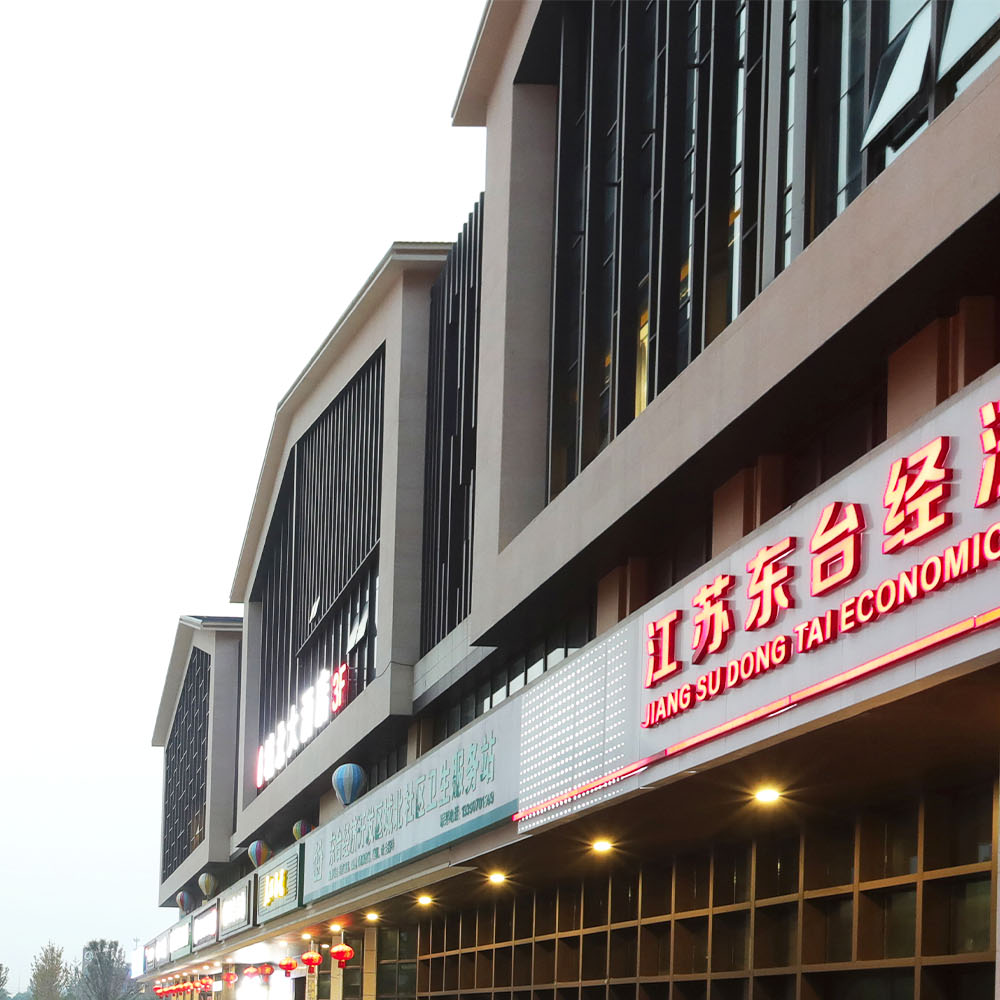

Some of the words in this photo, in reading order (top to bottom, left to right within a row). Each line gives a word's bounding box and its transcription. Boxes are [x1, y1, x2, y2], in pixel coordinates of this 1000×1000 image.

[332, 663, 349, 713] 3F
[641, 683, 694, 728] JIANG
[695, 666, 728, 701] SU
[728, 634, 792, 688] DONG
[793, 609, 838, 654] TAI
[839, 522, 1000, 633] ECONOMIC
